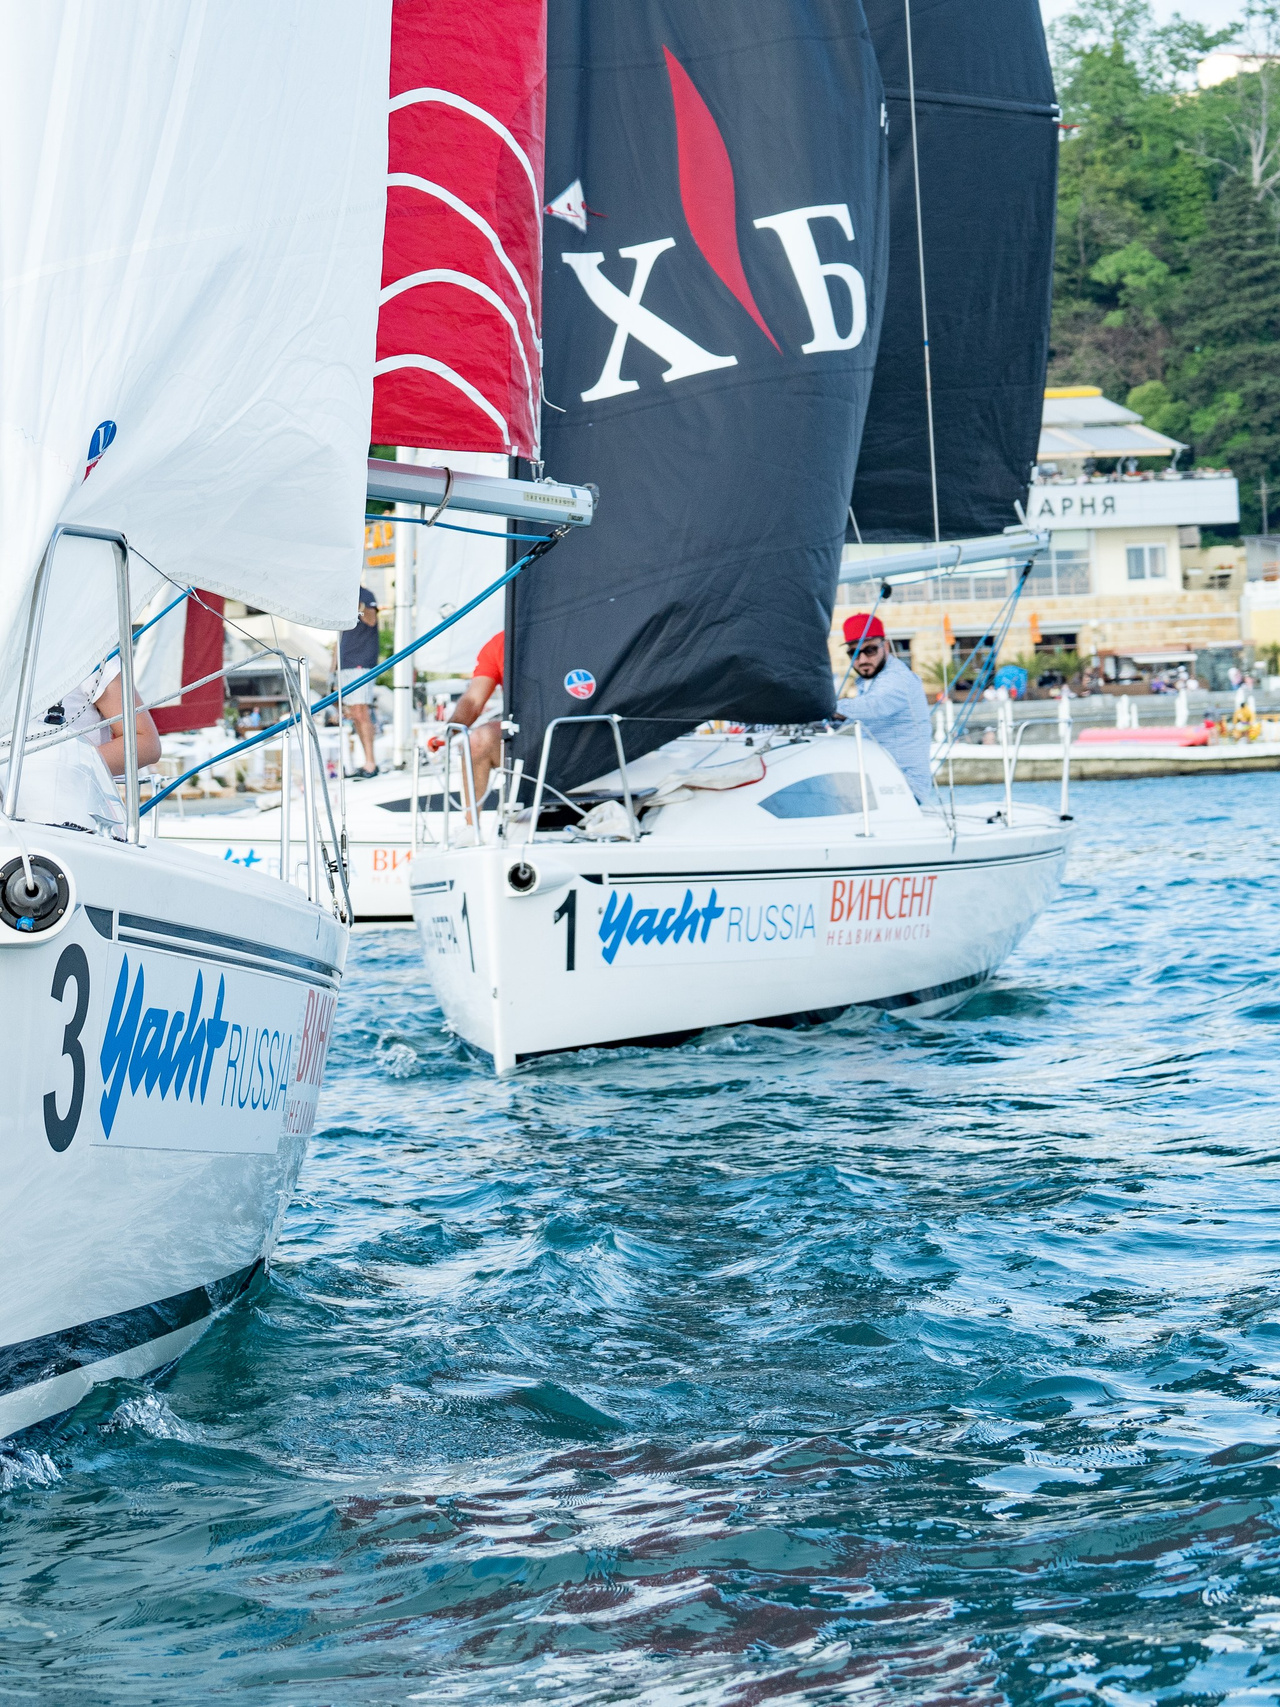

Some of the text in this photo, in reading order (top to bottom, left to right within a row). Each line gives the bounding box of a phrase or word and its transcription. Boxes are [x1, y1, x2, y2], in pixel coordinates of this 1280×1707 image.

[754, 203, 867, 355] Б
[1038, 496, 1116, 517] АРНЯ
[554, 889, 577, 971] 1
[598, 888, 816, 965] Yacht RUSSIA
[826, 923, 931, 946] НЕДВИЖИМОСТЬ
[830, 875, 938, 922] ВИНСЕНТ
[43, 943, 90, 1153] 3
[100, 952, 292, 1140] Yacht RUSSIA
